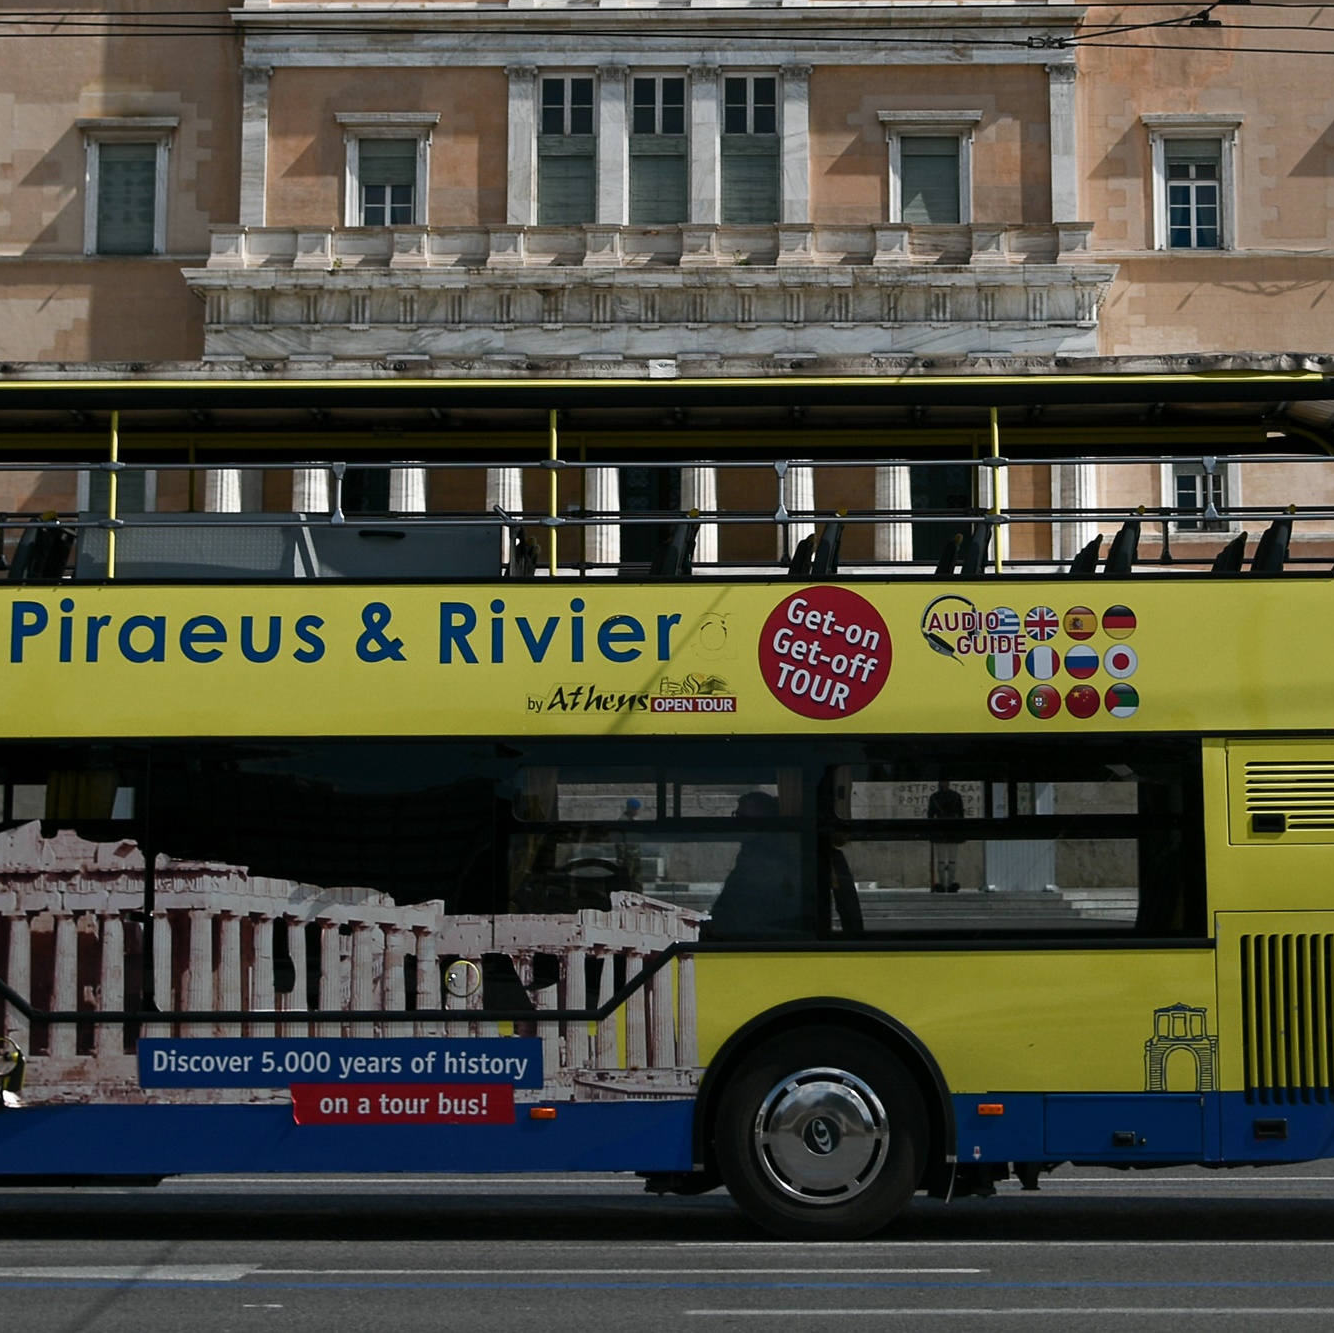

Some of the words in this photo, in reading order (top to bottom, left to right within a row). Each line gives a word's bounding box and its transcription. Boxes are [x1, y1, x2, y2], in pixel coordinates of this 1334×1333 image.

[355, 601, 407, 664] &
[786, 597, 881, 652] Get-on
[927, 611, 1001, 633] AUDIO
[772, 627, 879, 684] Get-off
[955, 634, 1028, 655] GUIDE
[527, 697, 543, 714] by
[547, 684, 649, 713] Athens
[653, 697, 693, 712] OPEN
[695, 697, 734, 712] TOUR
[777, 661, 851, 711] TOUR
[152, 1049, 253, 1073] Discover
[261, 1050, 331, 1073] 5.000
[338, 1055, 402, 1079] years
[410, 1051, 436, 1074] of
[443, 1051, 529, 1080] history
[319, 1095, 349, 1115] on
[357, 1096, 370, 1115] a
[379, 1093, 429, 1115] tour
[437, 1091, 488, 1116] bus!
